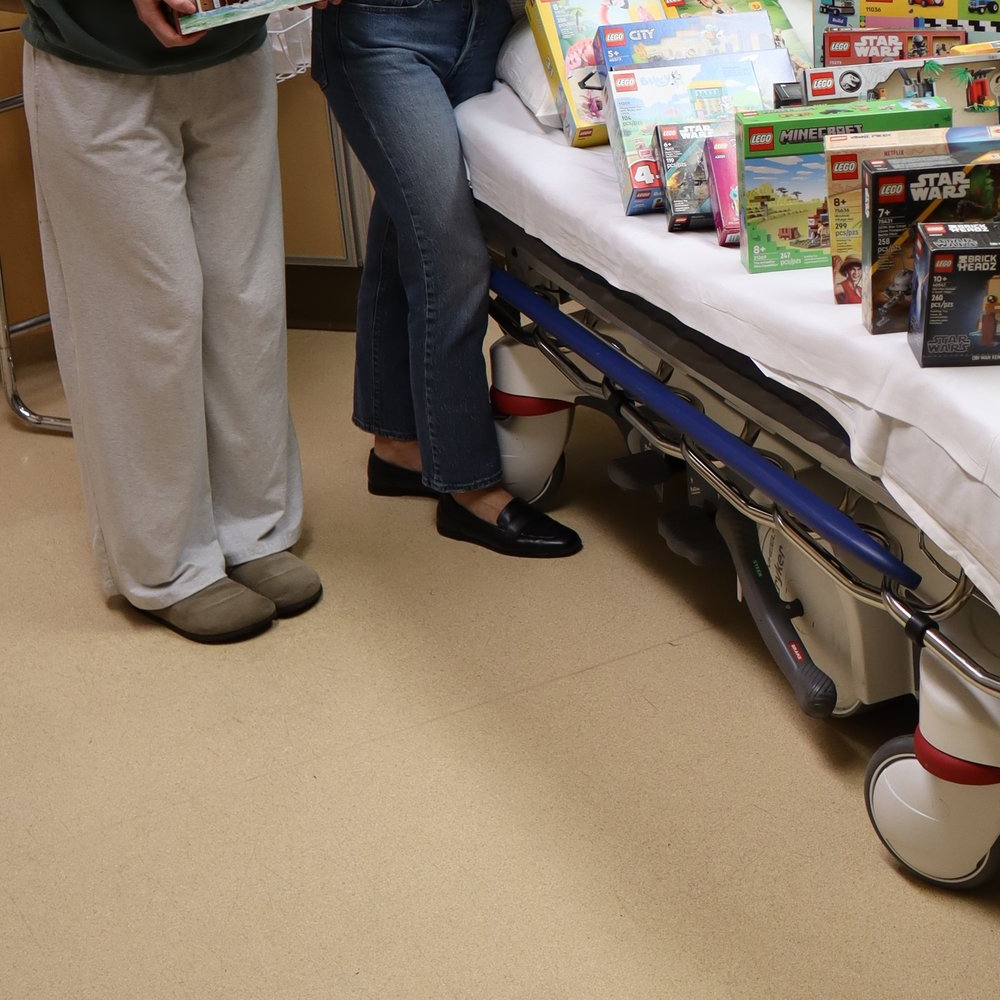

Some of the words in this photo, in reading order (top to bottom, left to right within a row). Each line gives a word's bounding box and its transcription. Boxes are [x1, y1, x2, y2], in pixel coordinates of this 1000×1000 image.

[605, 32, 624, 42] LEGO
[629, 28, 655, 41] CITY
[830, 42, 850, 51] LEGO
[854, 35, 903, 48] STAR
[854, 45, 903, 57] WARS
[616, 78, 635, 87] LEGO
[813, 79, 833, 90] LEGO
[679, 125, 713, 134] STAR
[779, 124, 864, 145] MINECRAFT
[680, 132, 714, 140] WARS
[751, 133, 772, 144] LEGO
[833, 161, 857, 173] LEGO
[910, 171, 970, 188] STAR
[880, 184, 903, 195] LEGO
[910, 184, 970, 201] WARS
[833, 197, 847, 207] 8+
[877, 208, 891, 218] 7+
[835, 228, 859, 237] pcs/pzs
[878, 238, 891, 246] 258
[753, 245, 766, 254] 8+
[935, 259, 953, 268] LEGO
[967, 254, 997, 263] BRICK
[957, 262, 997, 271] HEADZ
[930, 301, 954, 309] pcs/pzs
[928, 335, 970, 344] STAR
[928, 342, 970, 353] WARS
[791, 644, 802, 660] BRAKE
